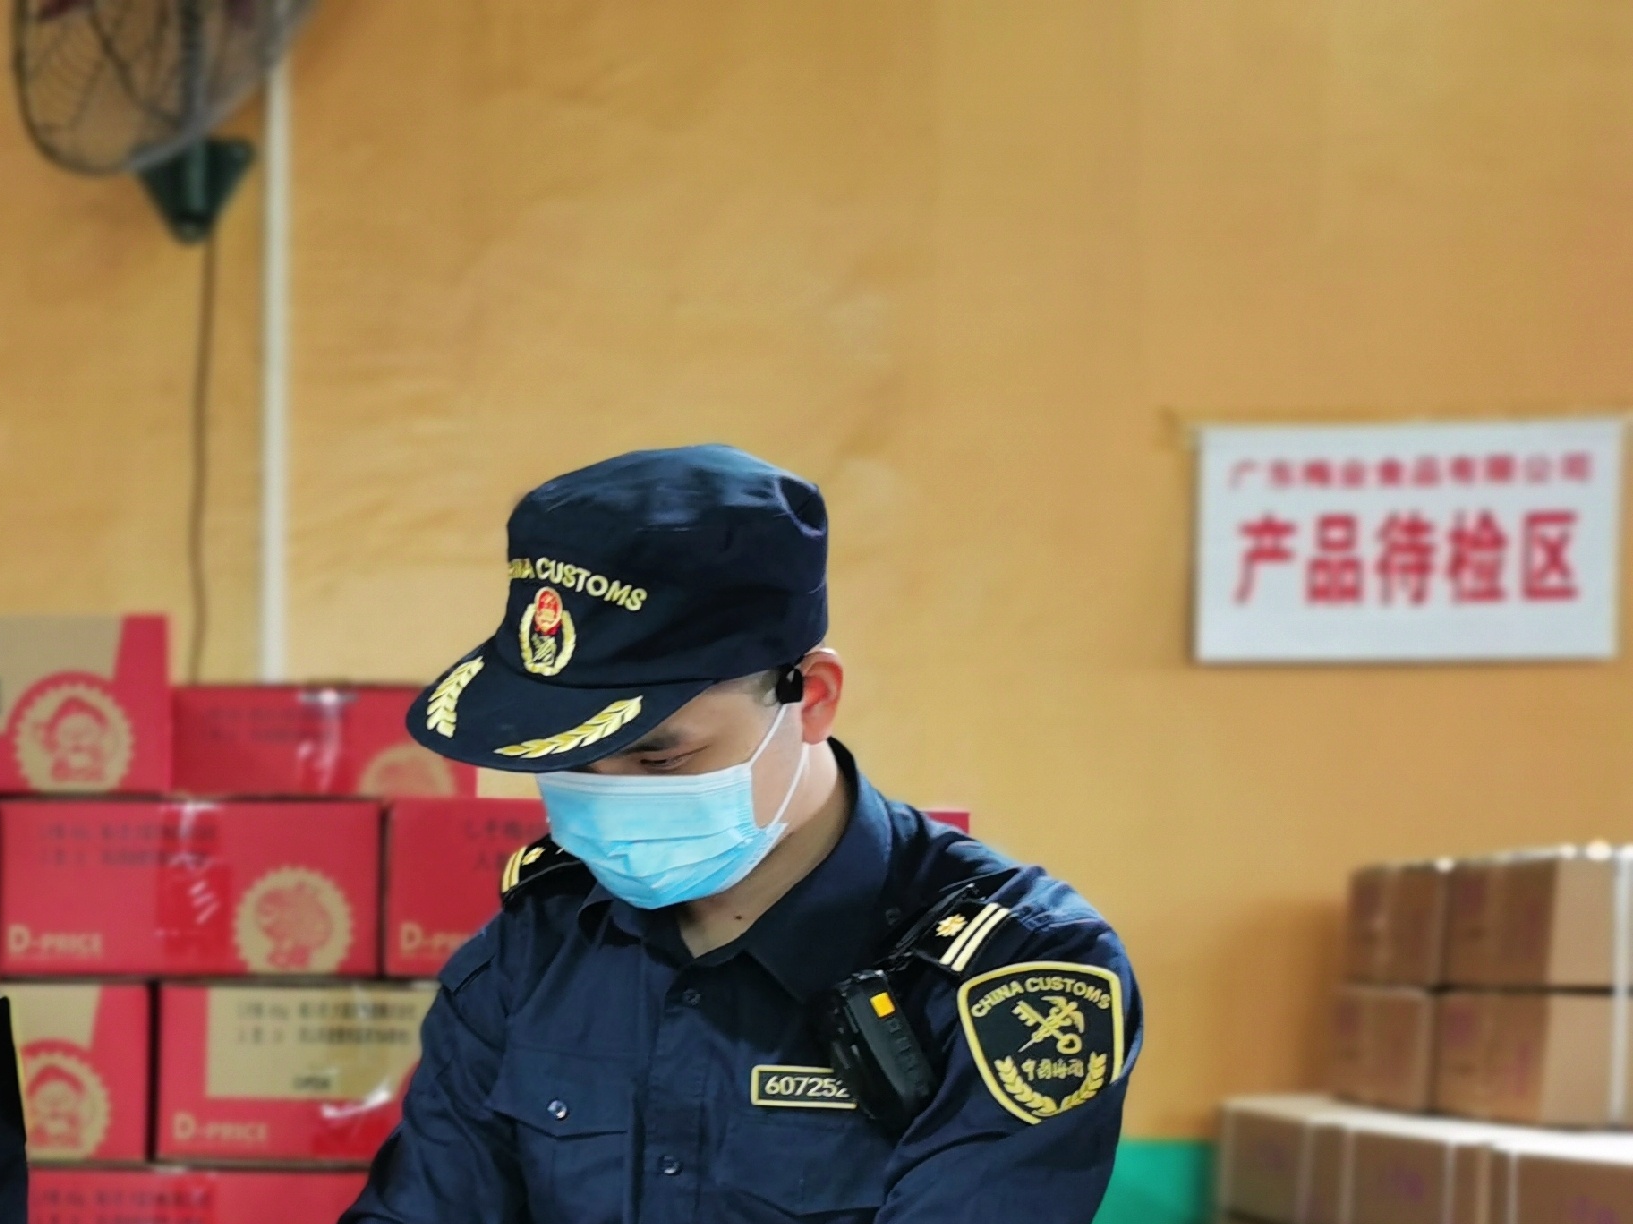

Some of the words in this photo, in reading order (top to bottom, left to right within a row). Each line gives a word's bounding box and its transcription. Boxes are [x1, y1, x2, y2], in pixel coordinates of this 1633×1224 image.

[535, 557, 648, 611] CUSTOMS
[1234, 509, 1579, 607] 产品待检区
[971, 979, 1023, 1019] CHINA
[1024, 975, 1111, 1011] CUSTOMS
